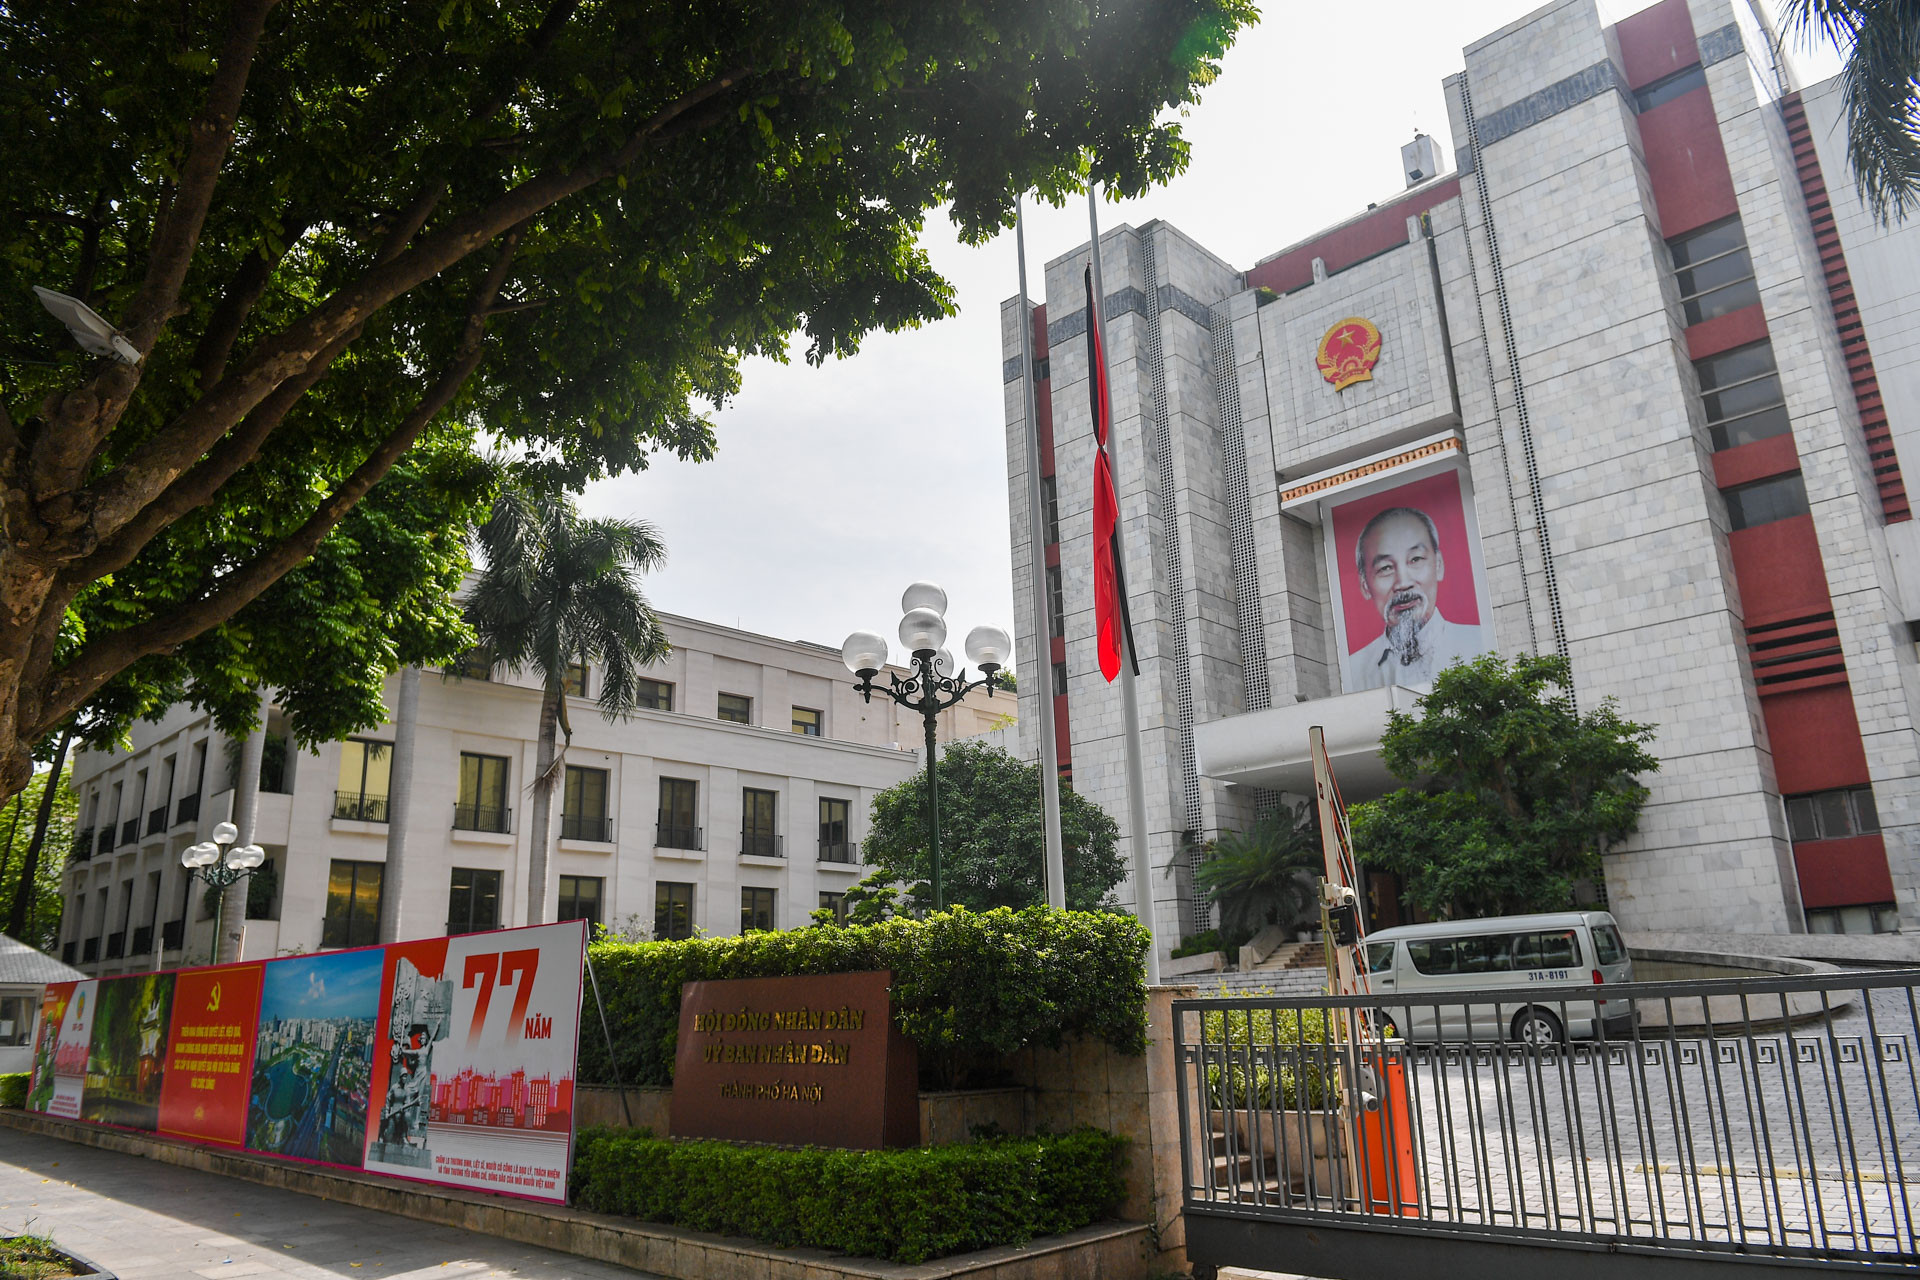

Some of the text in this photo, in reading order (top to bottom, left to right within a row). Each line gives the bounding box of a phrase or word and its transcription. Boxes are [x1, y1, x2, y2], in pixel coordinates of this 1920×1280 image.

[463, 948, 552, 1050] 77 NĂM
[694, 1005, 864, 1036] HỘI ĐỒNG NHÂN DÂN
[724, 1044, 758, 1064] BAN
[759, 1040, 807, 1064] NHÂN
[811, 1039, 850, 1065] DÂN
[719, 1080, 755, 1099] THÀNH
[757, 1079, 782, 1100] PHỐ
[801, 1082, 824, 1105] NỘI
